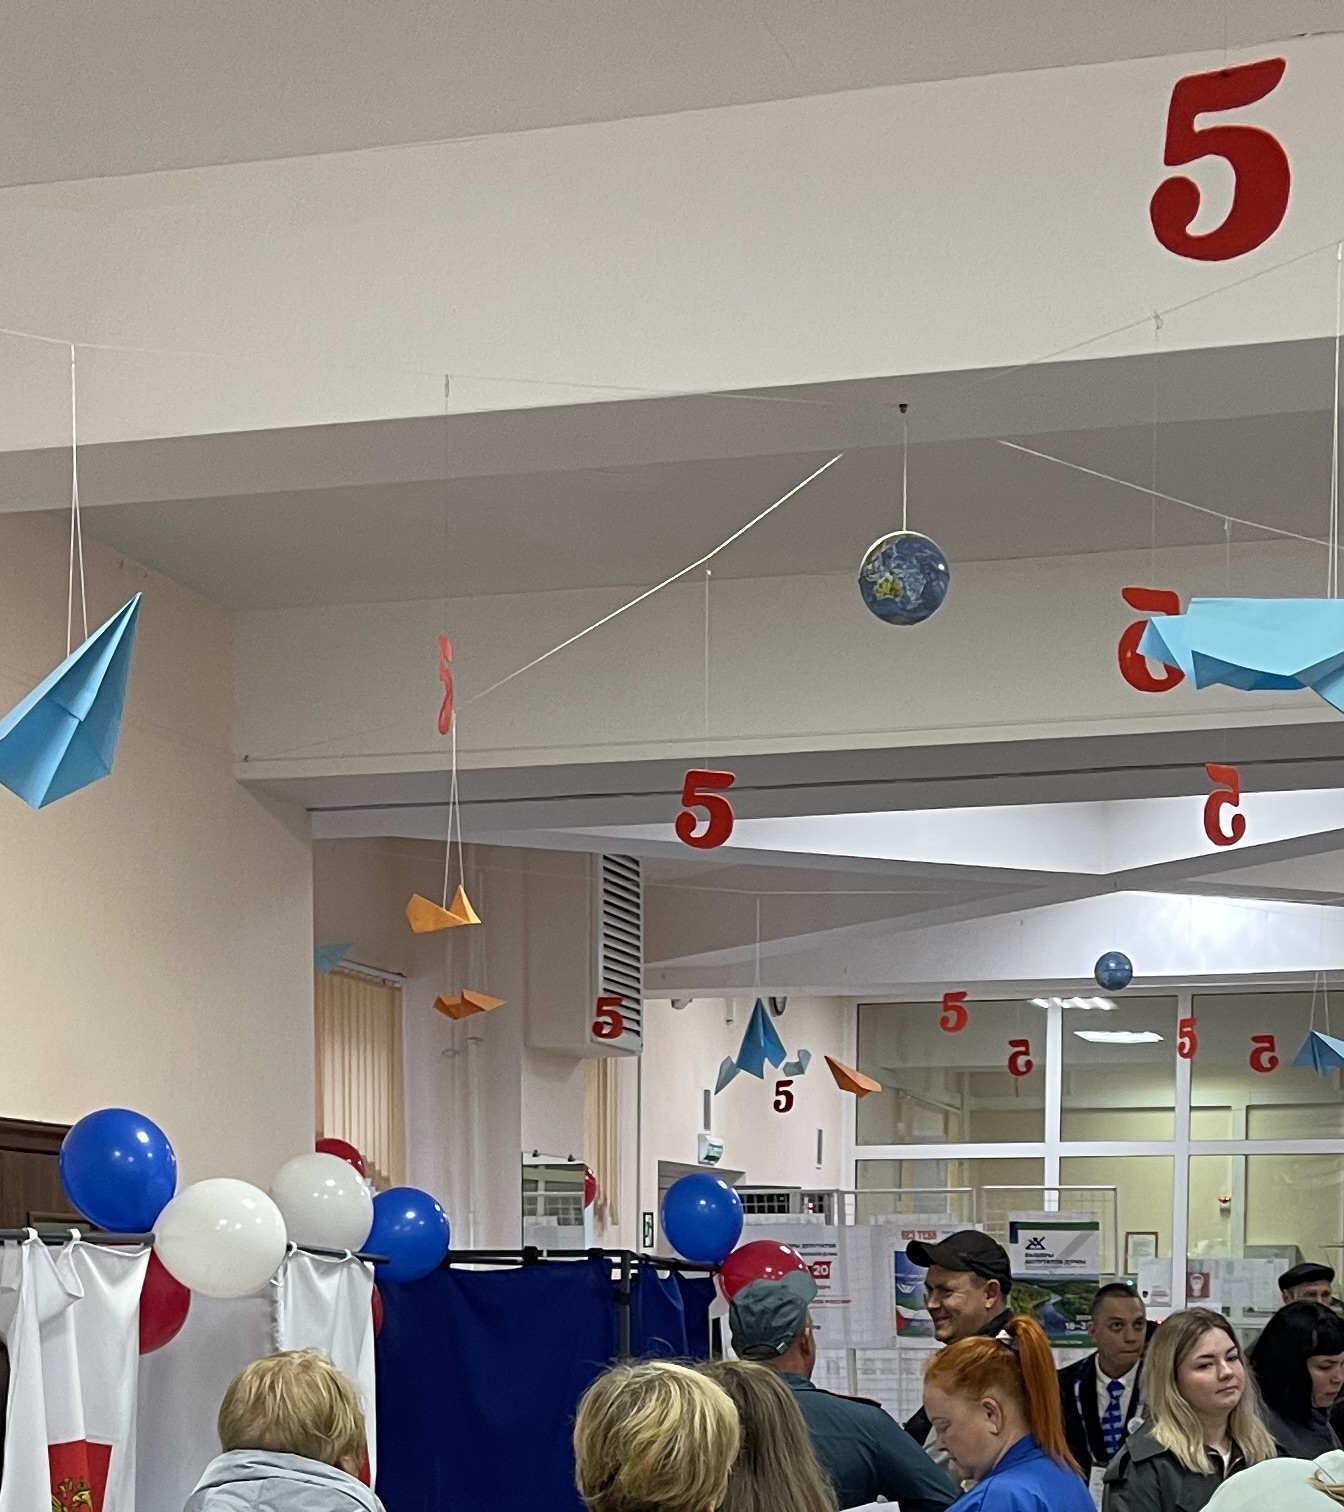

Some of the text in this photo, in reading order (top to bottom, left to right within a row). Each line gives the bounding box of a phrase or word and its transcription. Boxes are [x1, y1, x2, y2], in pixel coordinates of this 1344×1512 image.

[1149, 57, 1291, 261] 5
[674, 768, 735, 849] 5
[592, 996, 624, 1039] 5
[940, 991, 968, 1033] 5
[1177, 1016, 1198, 1059] 5
[773, 1079, 794, 1113] 5
